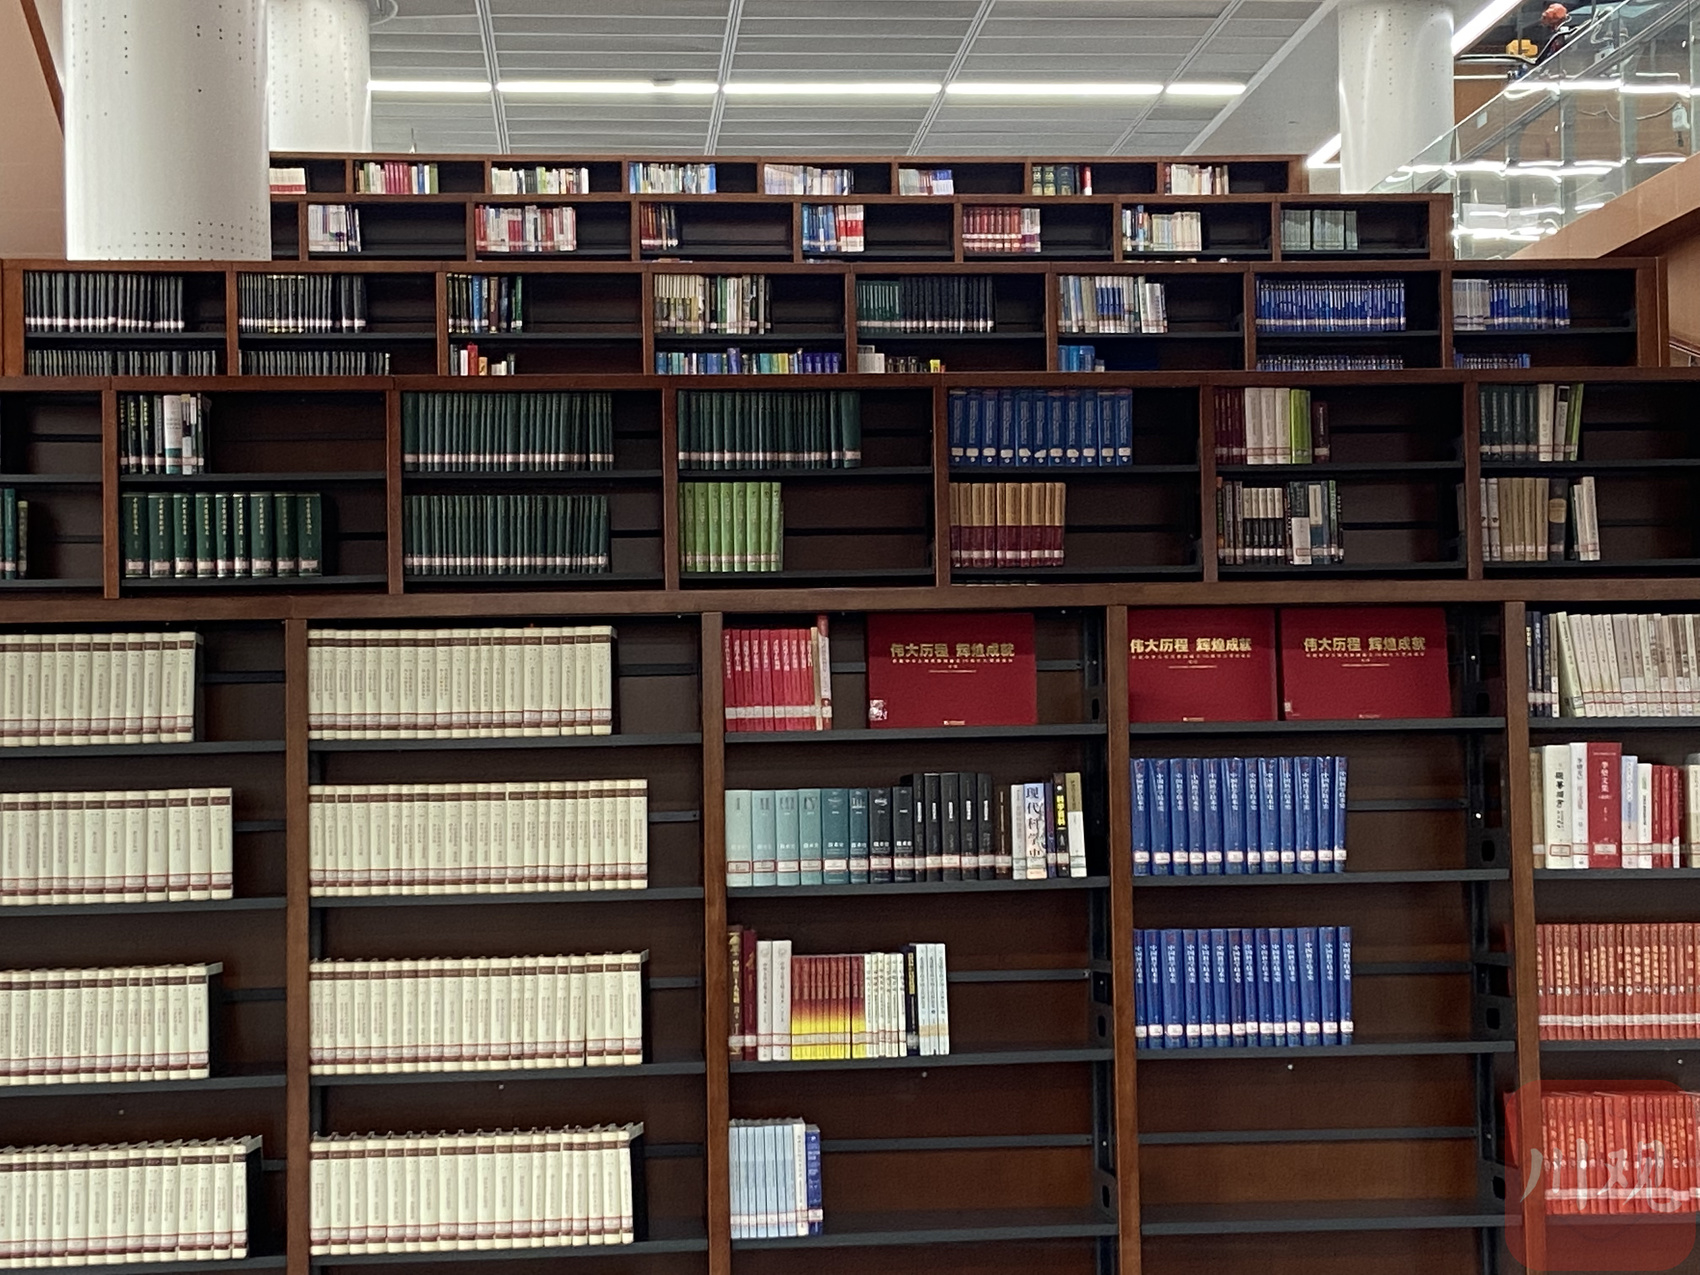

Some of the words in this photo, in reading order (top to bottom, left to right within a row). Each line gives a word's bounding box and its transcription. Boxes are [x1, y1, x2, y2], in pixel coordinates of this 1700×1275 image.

[890, 643, 949, 657] 伟大历程
[956, 643, 1015, 657] 辉煌成就
[1130, 638, 1189, 653] 伟大历程
[1196, 638, 1252, 652] 辉煌成就
[1304, 638, 1361, 652] 伟大历程
[1368, 637, 1426, 651] 辉煌成就
